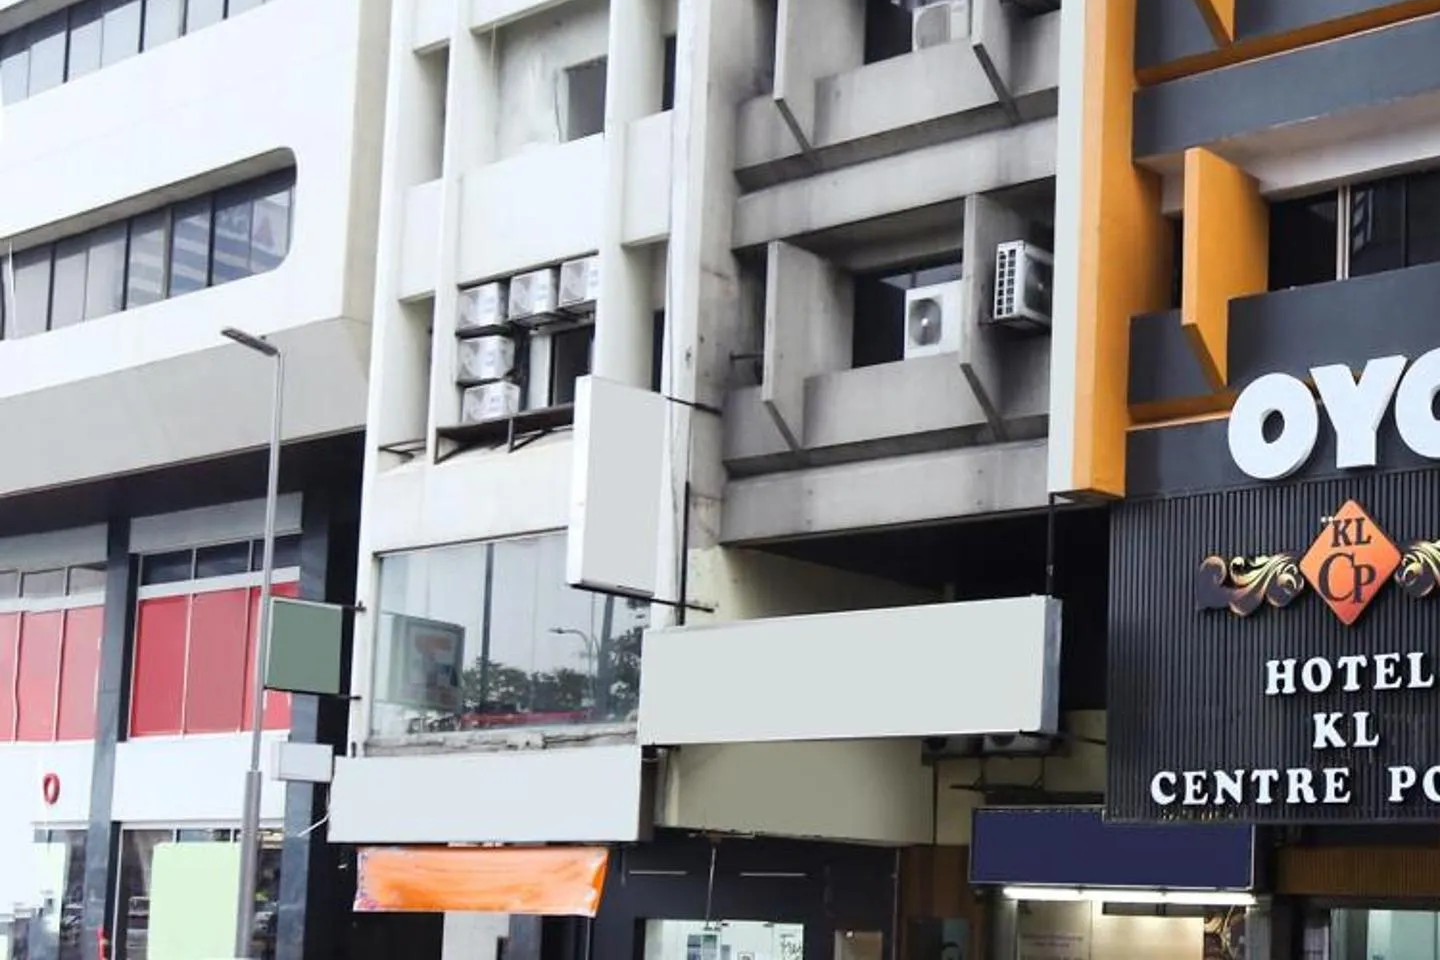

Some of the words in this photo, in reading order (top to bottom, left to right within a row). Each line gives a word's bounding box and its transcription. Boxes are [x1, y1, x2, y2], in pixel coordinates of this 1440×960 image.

[1331, 517, 1373, 549] KL
[1318, 552, 1376, 604] CP
[1264, 652, 1434, 695] HOTEL
[1312, 711, 1380, 749] KL
[1150, 767, 1352, 806] CENTRE
